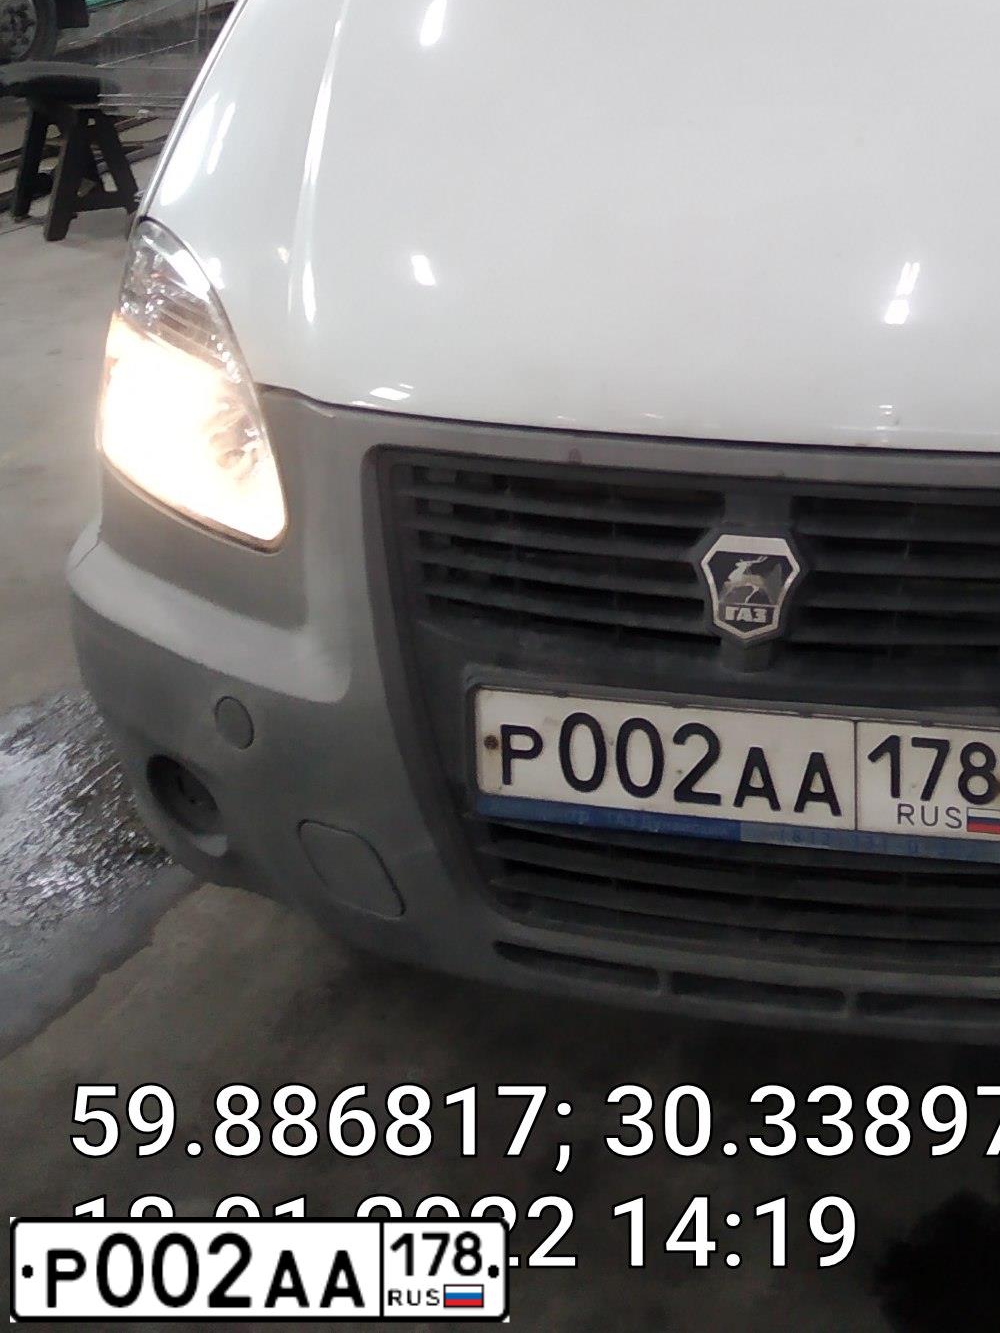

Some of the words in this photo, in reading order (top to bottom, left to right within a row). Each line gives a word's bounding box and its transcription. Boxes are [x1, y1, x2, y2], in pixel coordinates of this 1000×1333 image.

[724, 605, 768, 623] ГАЗ
[499, 711, 843, 818] Р002АА
[866, 733, 999, 807] 178
[896, 802, 963, 830] RUS
